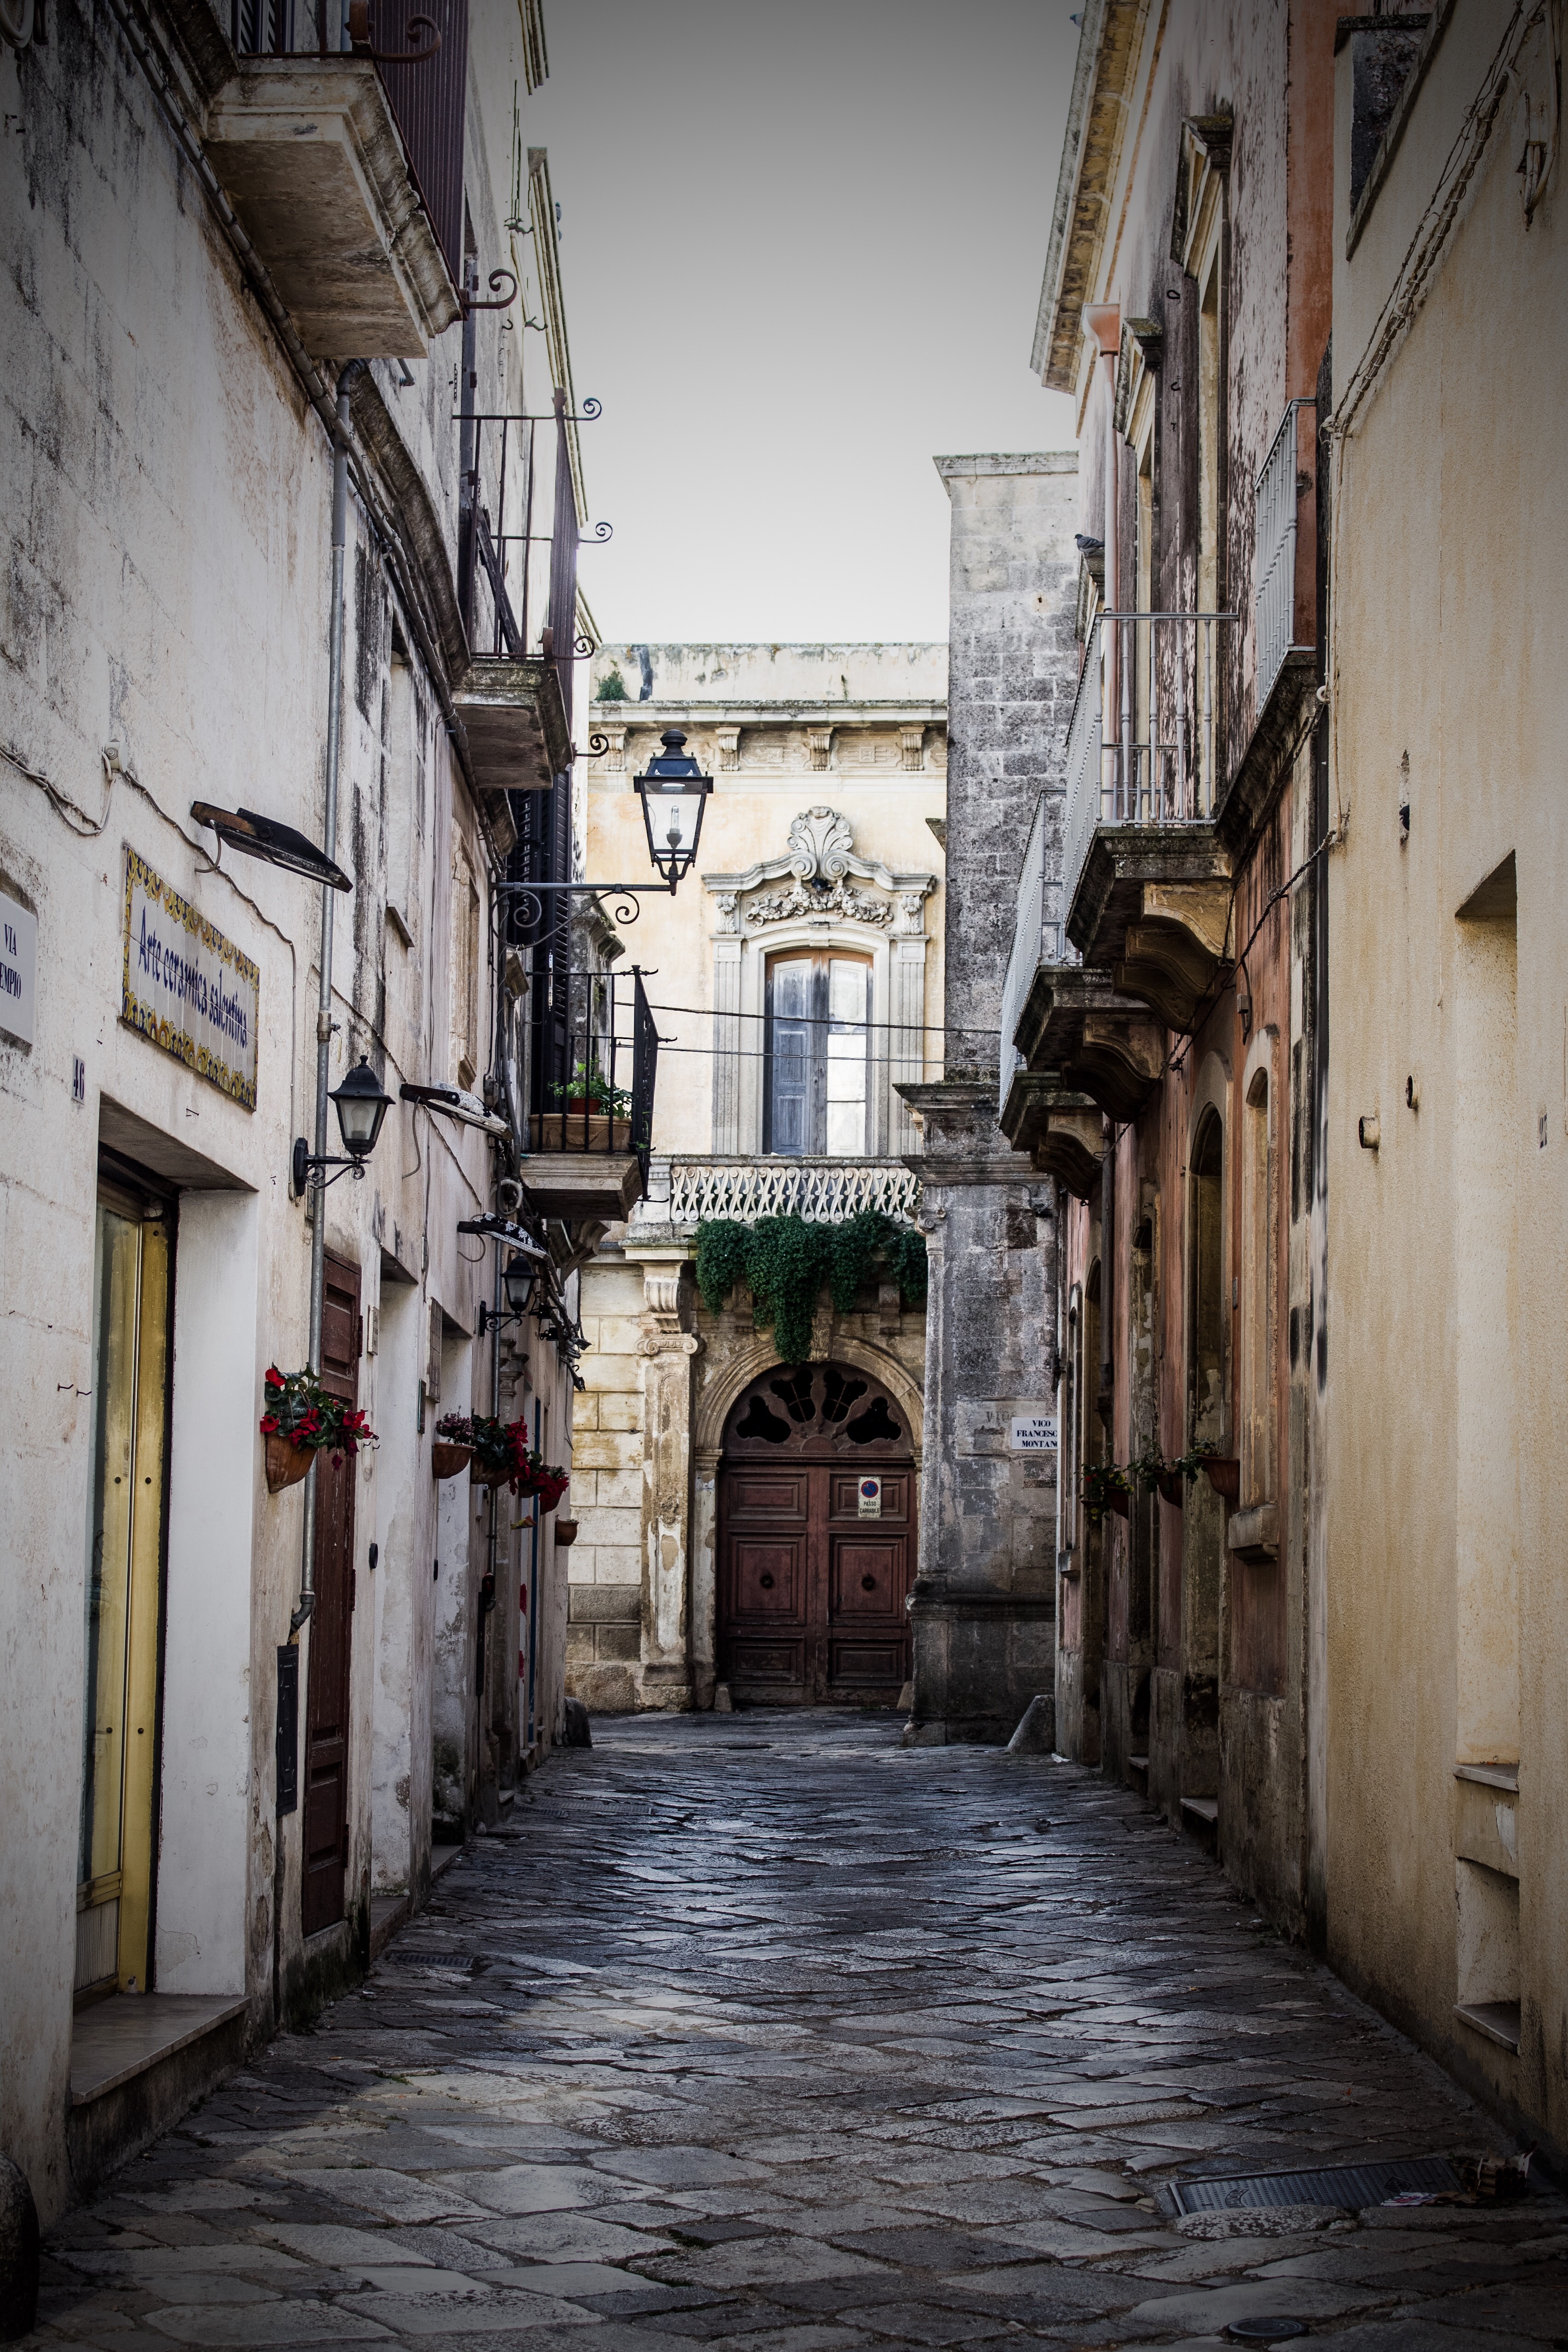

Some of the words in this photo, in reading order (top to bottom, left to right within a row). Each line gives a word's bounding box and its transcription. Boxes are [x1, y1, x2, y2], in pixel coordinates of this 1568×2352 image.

[4, 923, 17, 956] VIA
[139, 905, 161, 982] Arte
[163, 947, 208, 1016] ceramica
[209, 968, 248, 1049] salentina
[74, 1059, 84, 1100] 46
